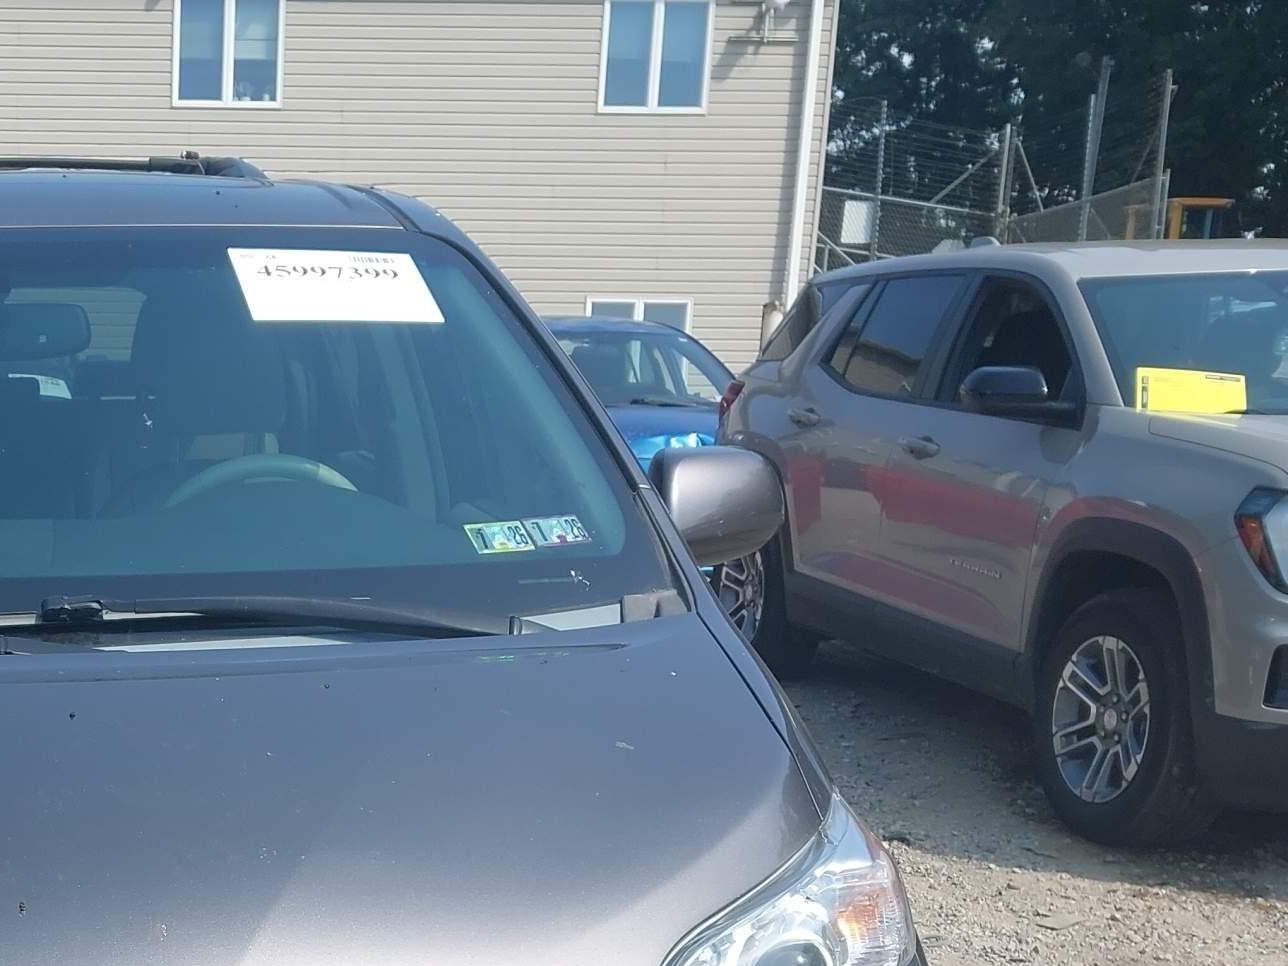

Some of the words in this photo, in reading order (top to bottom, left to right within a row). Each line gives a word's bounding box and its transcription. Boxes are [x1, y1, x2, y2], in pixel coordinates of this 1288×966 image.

[256, 264, 399, 280] 45997399
[507, 525, 529, 545] 26
[563, 518, 587, 541] 26
